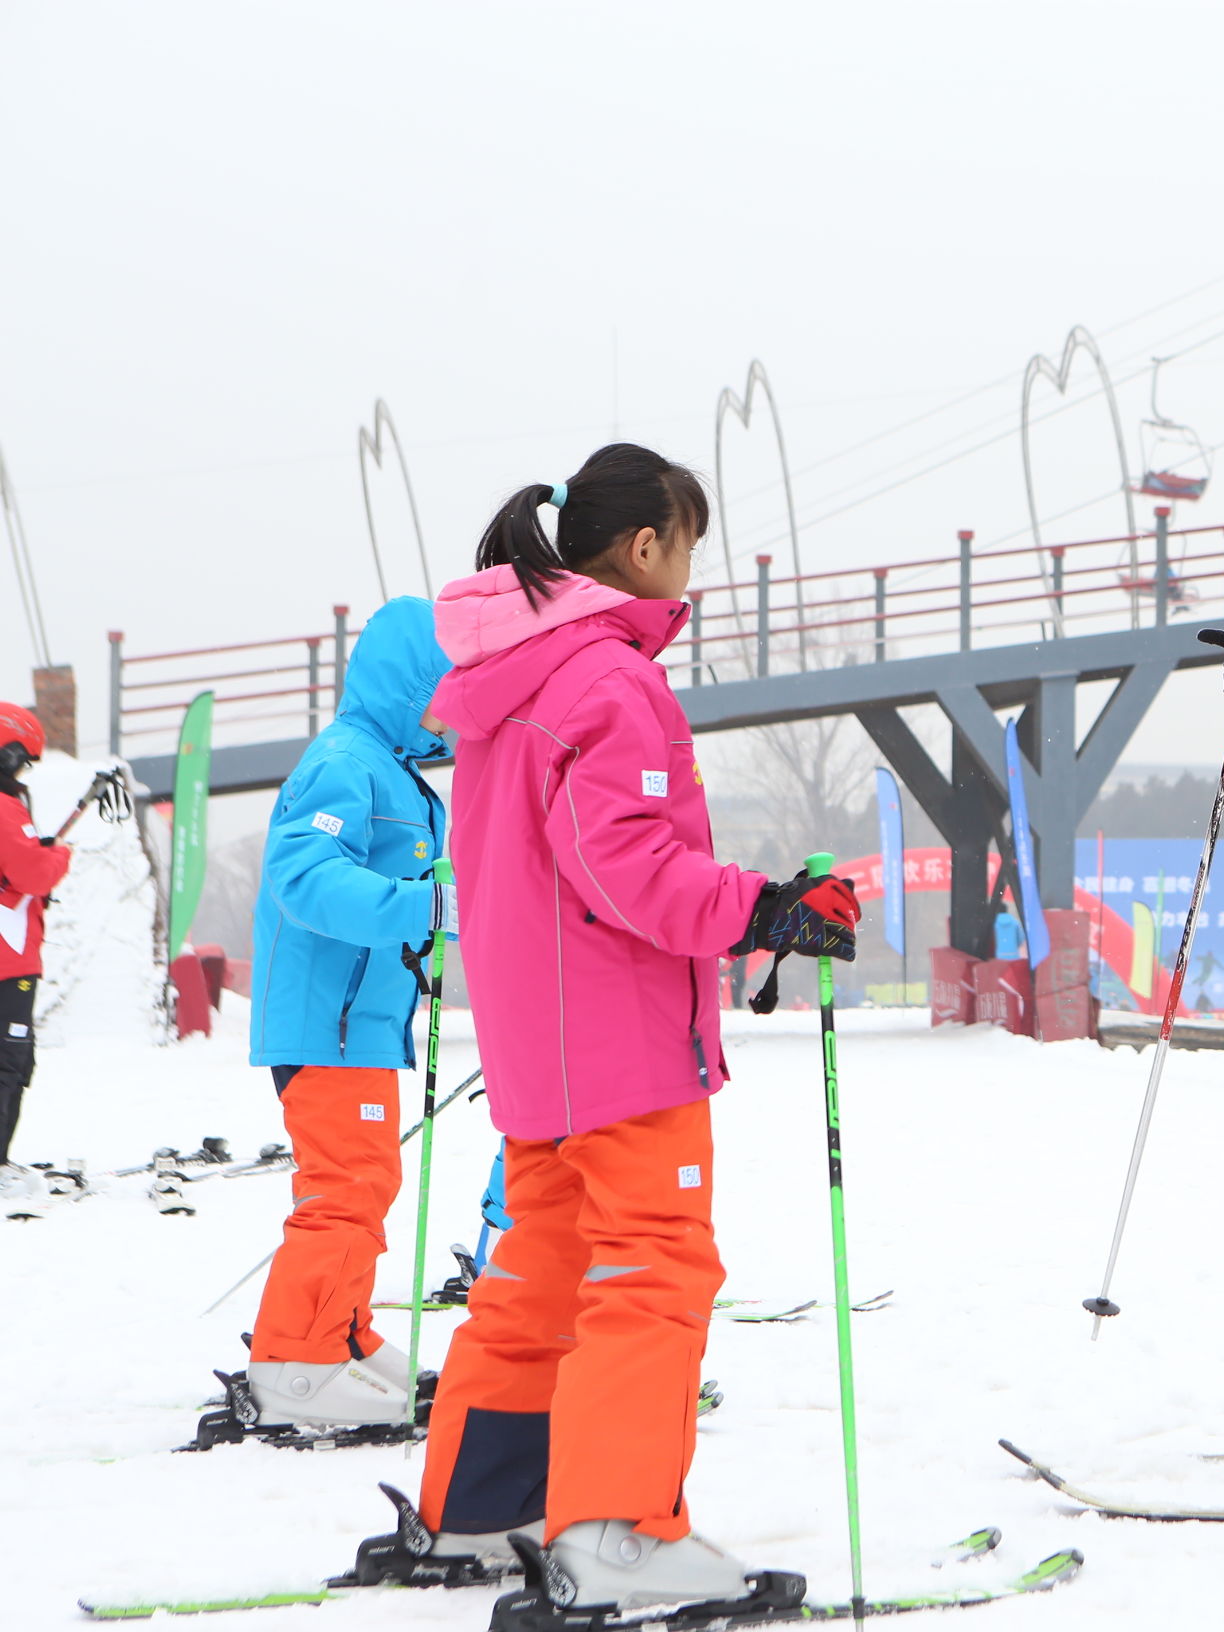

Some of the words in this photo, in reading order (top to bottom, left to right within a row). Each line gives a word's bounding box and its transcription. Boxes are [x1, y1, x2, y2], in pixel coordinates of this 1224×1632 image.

[316, 816, 340, 833] 145
[363, 1106, 383, 1119] 145
[681, 1168, 700, 1184] 150
